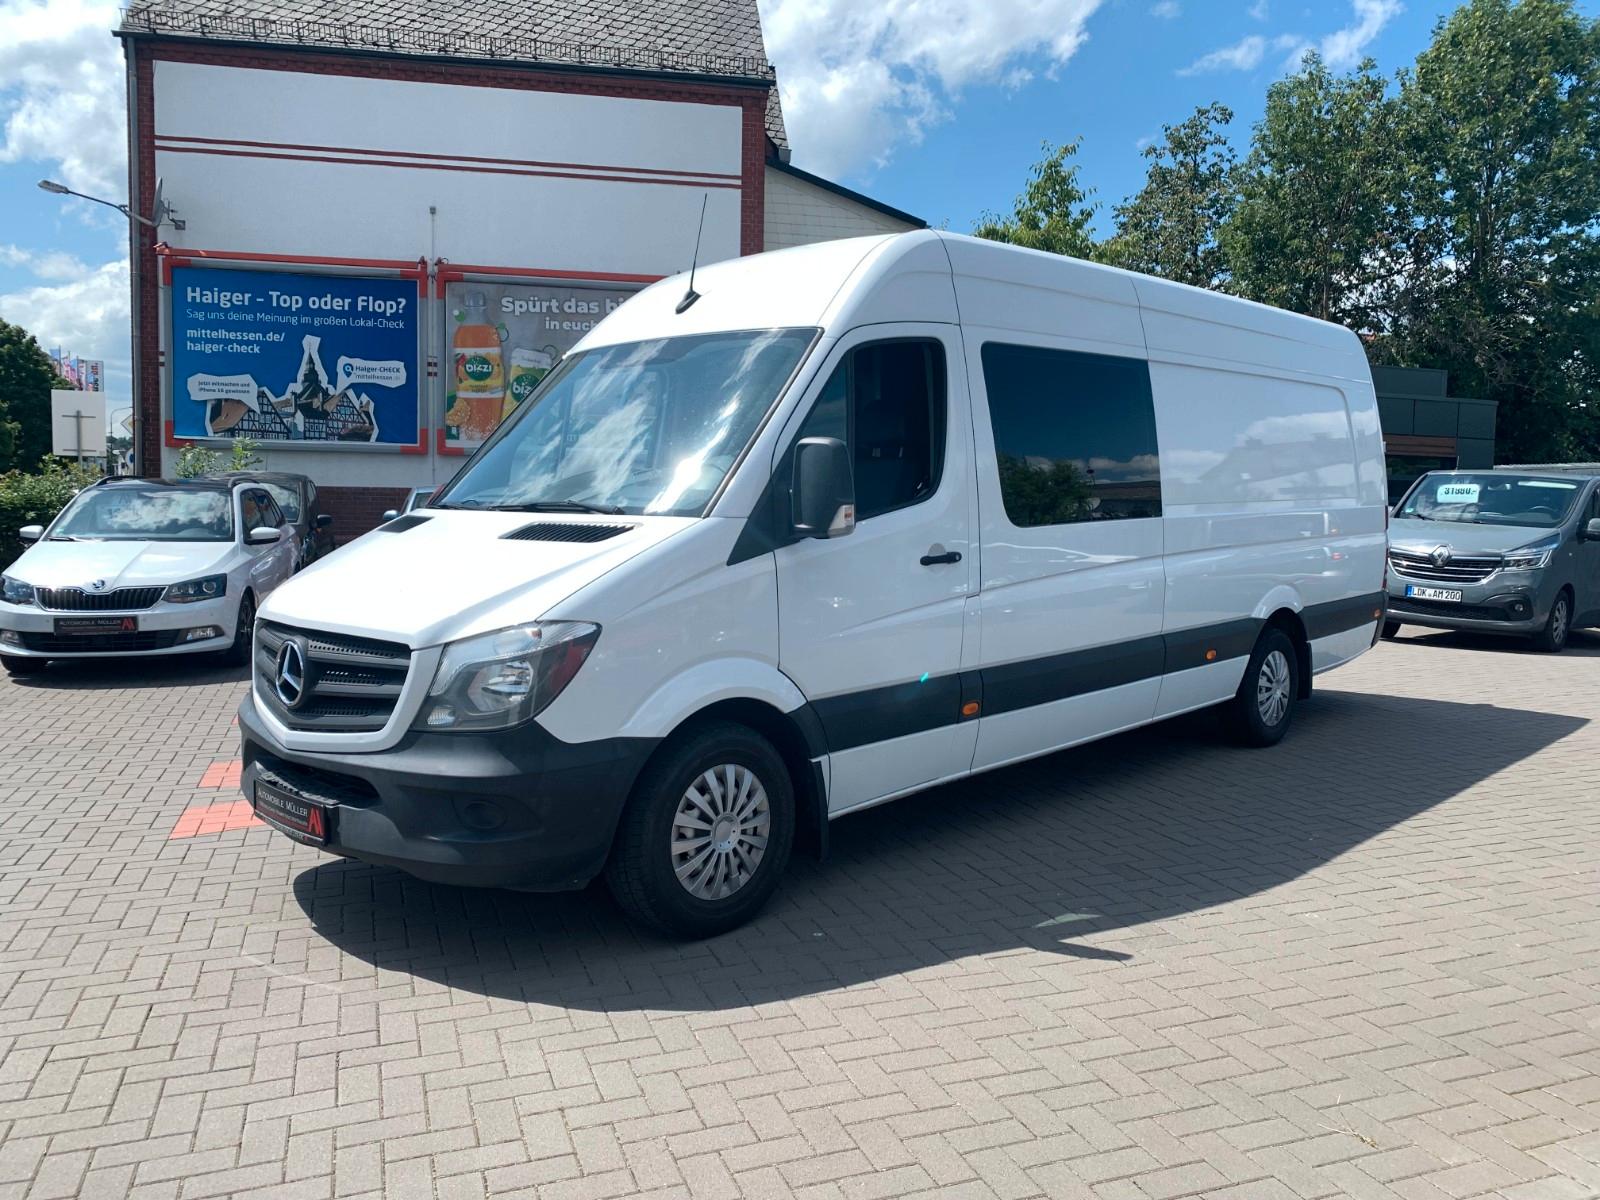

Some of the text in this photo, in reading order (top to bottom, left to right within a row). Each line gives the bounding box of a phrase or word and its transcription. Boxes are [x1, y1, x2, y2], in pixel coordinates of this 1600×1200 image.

[186, 286, 252, 309] Haiger
[268, 290, 303, 312] Top
[308, 293, 352, 311] oder
[357, 295, 407, 317] Flop?
[501, 296, 560, 316] Spürt
[563, 298, 600, 314] das
[186, 308, 205, 321] Sag
[227, 310, 254, 321] deine
[256, 312, 298, 326] Meinung
[300, 314, 312, 324] im
[313, 316, 347, 327] großen
[349, 317, 405, 329] Lokal-Check
[545, 316, 560, 330] in
[186, 327, 286, 343] mittelhessen.de/
[186, 340, 261, 354] haiger-check
[1412, 587, 1461, 600] LDK AM 200
[257, 787, 285, 808] AUTOMOBILE
[285, 800, 308, 817] MÜLLER
